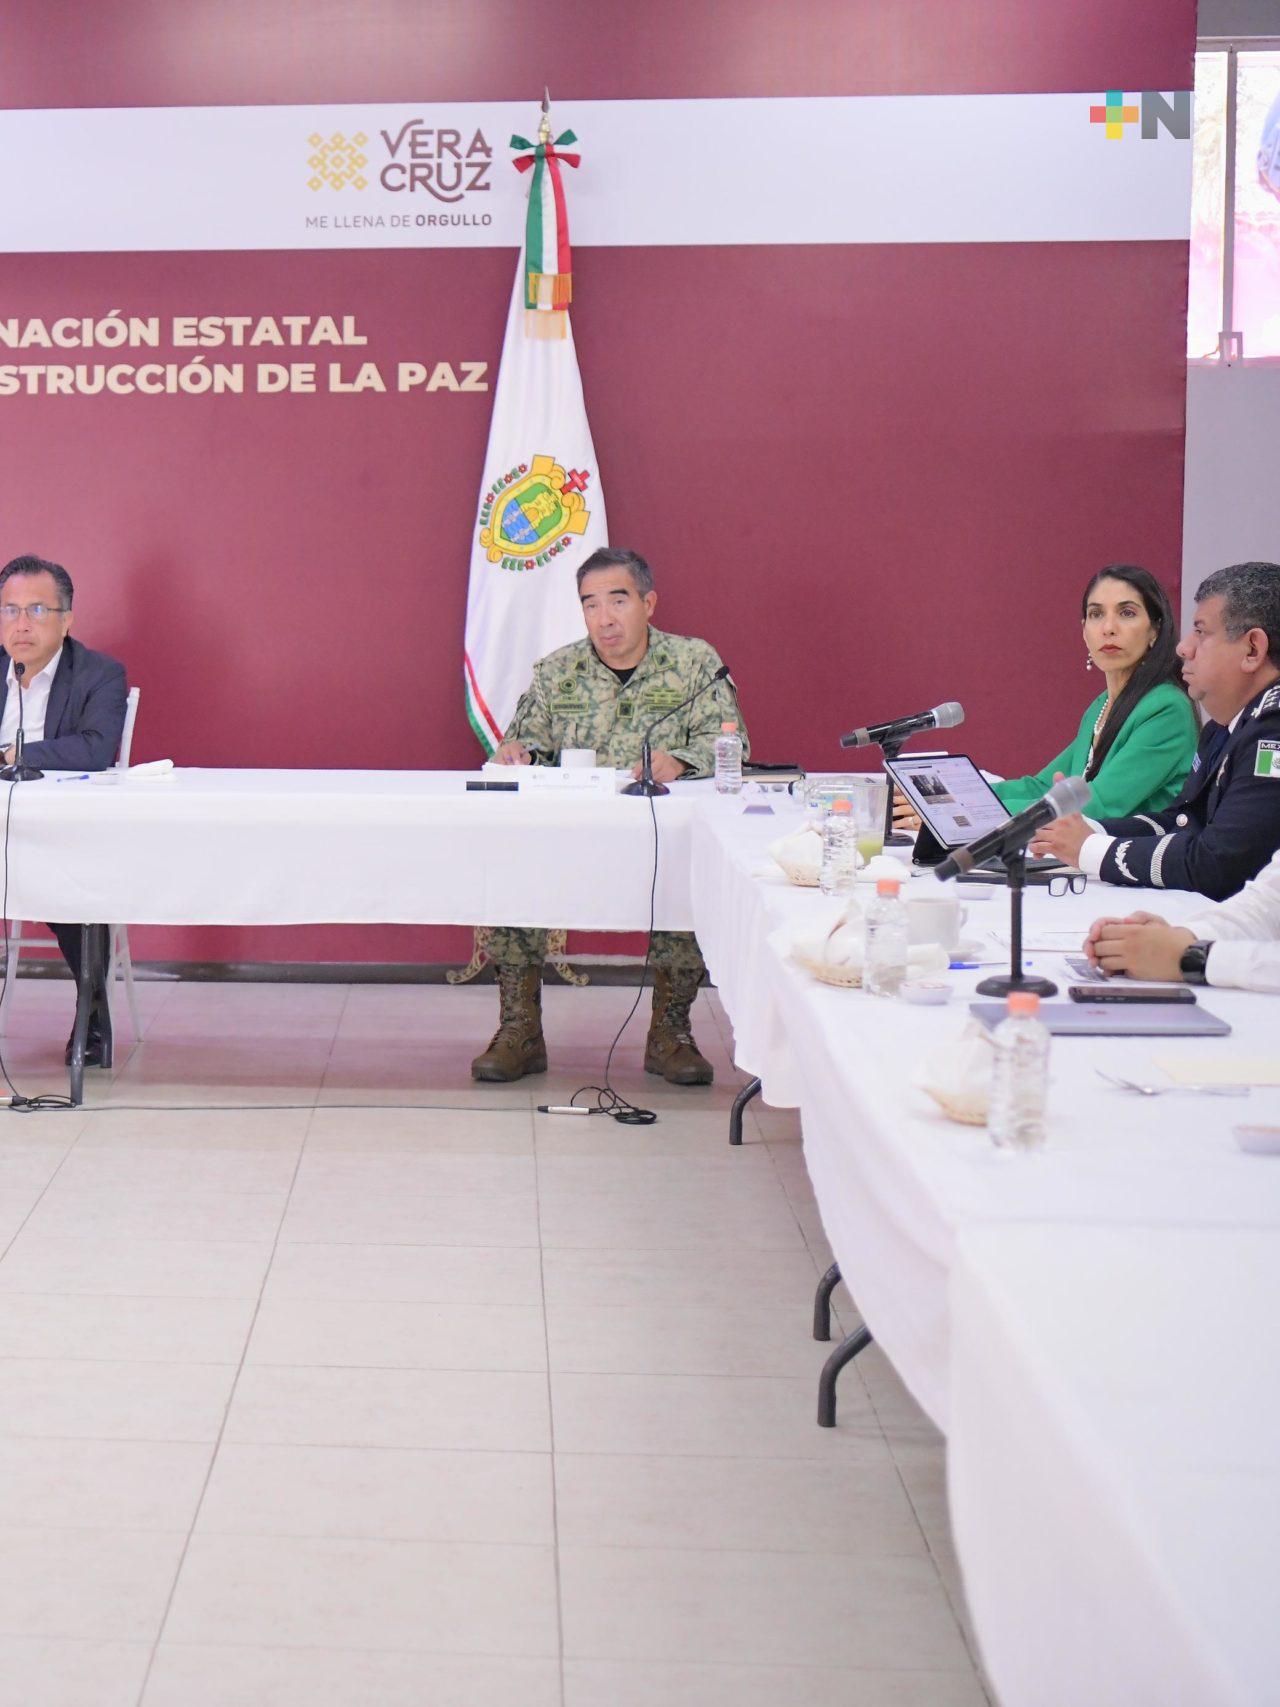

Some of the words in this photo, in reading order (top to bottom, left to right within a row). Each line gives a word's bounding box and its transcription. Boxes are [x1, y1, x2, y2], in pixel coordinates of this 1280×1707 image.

[380, 119, 493, 160] VERA
[380, 161, 492, 203] CRUZ
[306, 216, 328, 228] ME
[334, 215, 386, 228] LLENA
[390, 215, 411, 227] DE
[415, 213, 492, 227] ORGULLO
[173, 315, 368, 347] ESTATAL
[257, 363, 316, 393] DE
[329, 362, 386, 392] LA
[398, 361, 489, 392] PAZ
